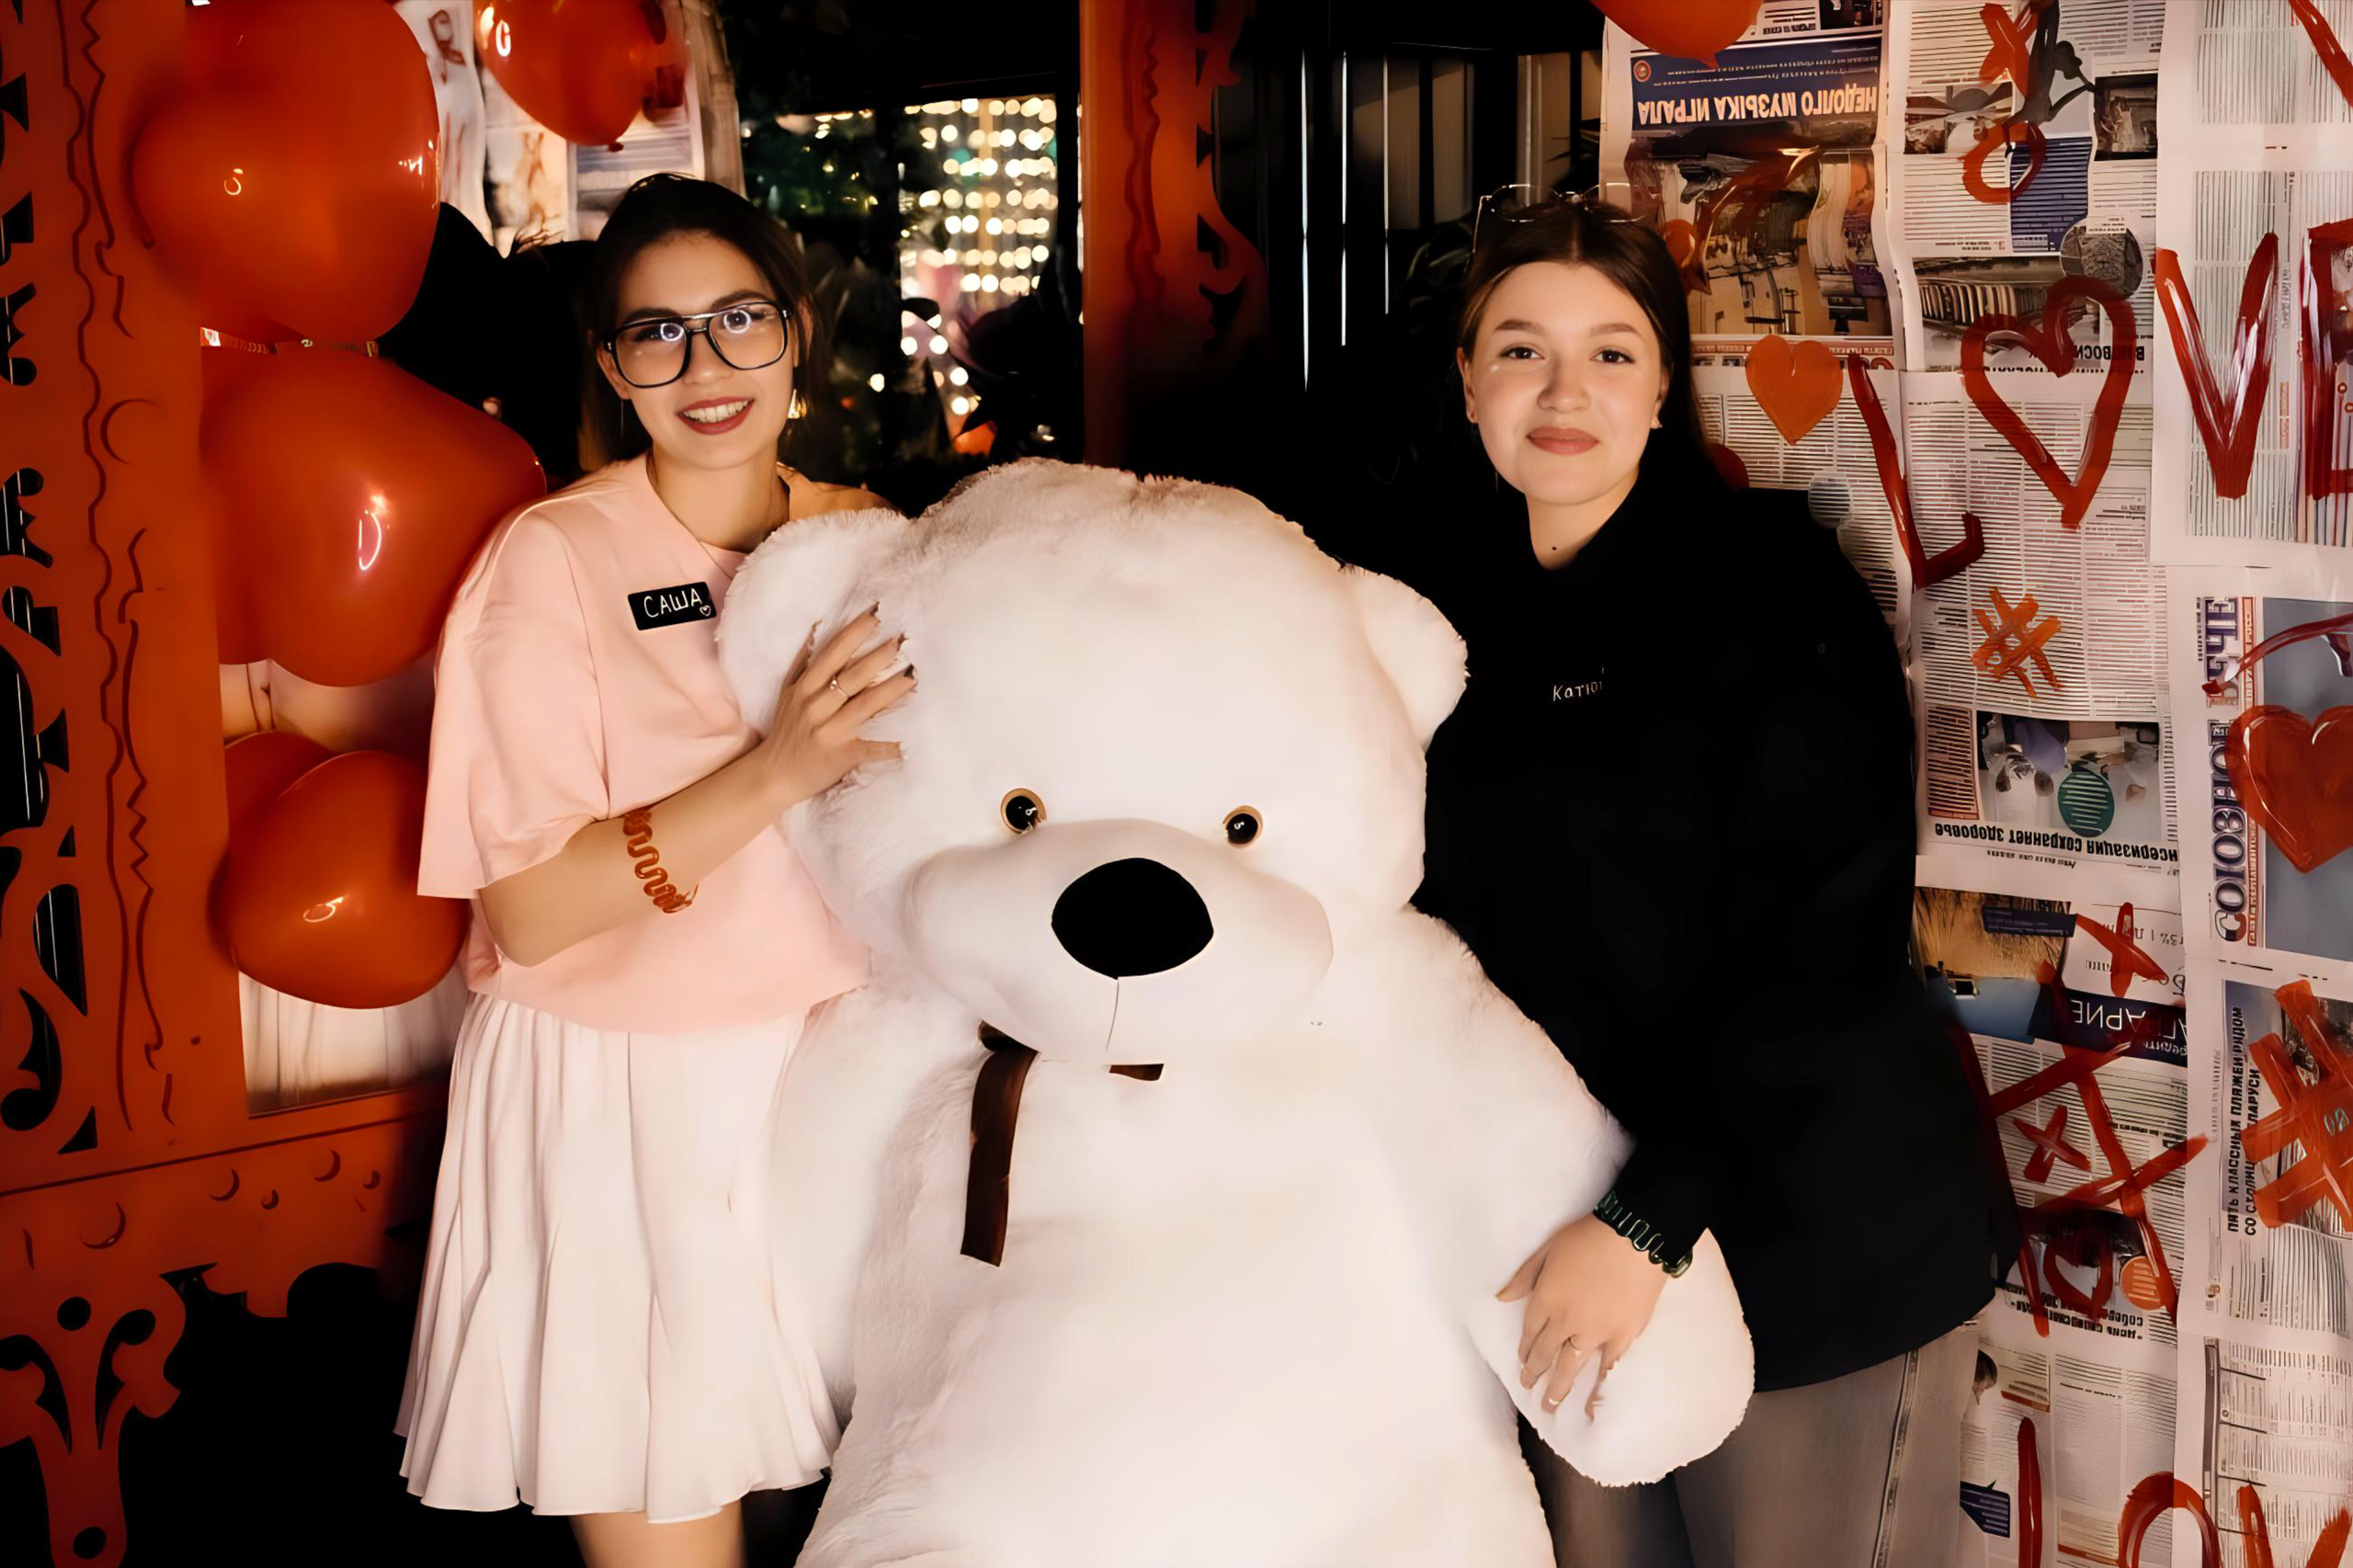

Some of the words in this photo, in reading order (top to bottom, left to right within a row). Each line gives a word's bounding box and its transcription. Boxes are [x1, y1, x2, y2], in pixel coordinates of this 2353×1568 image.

[1636, 97, 1711, 126] ИГРАЛА
[1713, 91, 1797, 122] МУЗЫКА
[1802, 82, 1878, 117] НЕДОЛГО
[642, 586, 703, 619] САША
[1934, 822, 2005, 844] здоровье
[2008, 829, 2083, 853] сохраняет
[2231, 1006, 2246, 1053] РЯДОМ
[2228, 1119, 2243, 1194] КЛАССНЫХ
[2227, 1199, 2240, 1233] ПЯТЬ
[2244, 1217, 2257, 1236] СО
